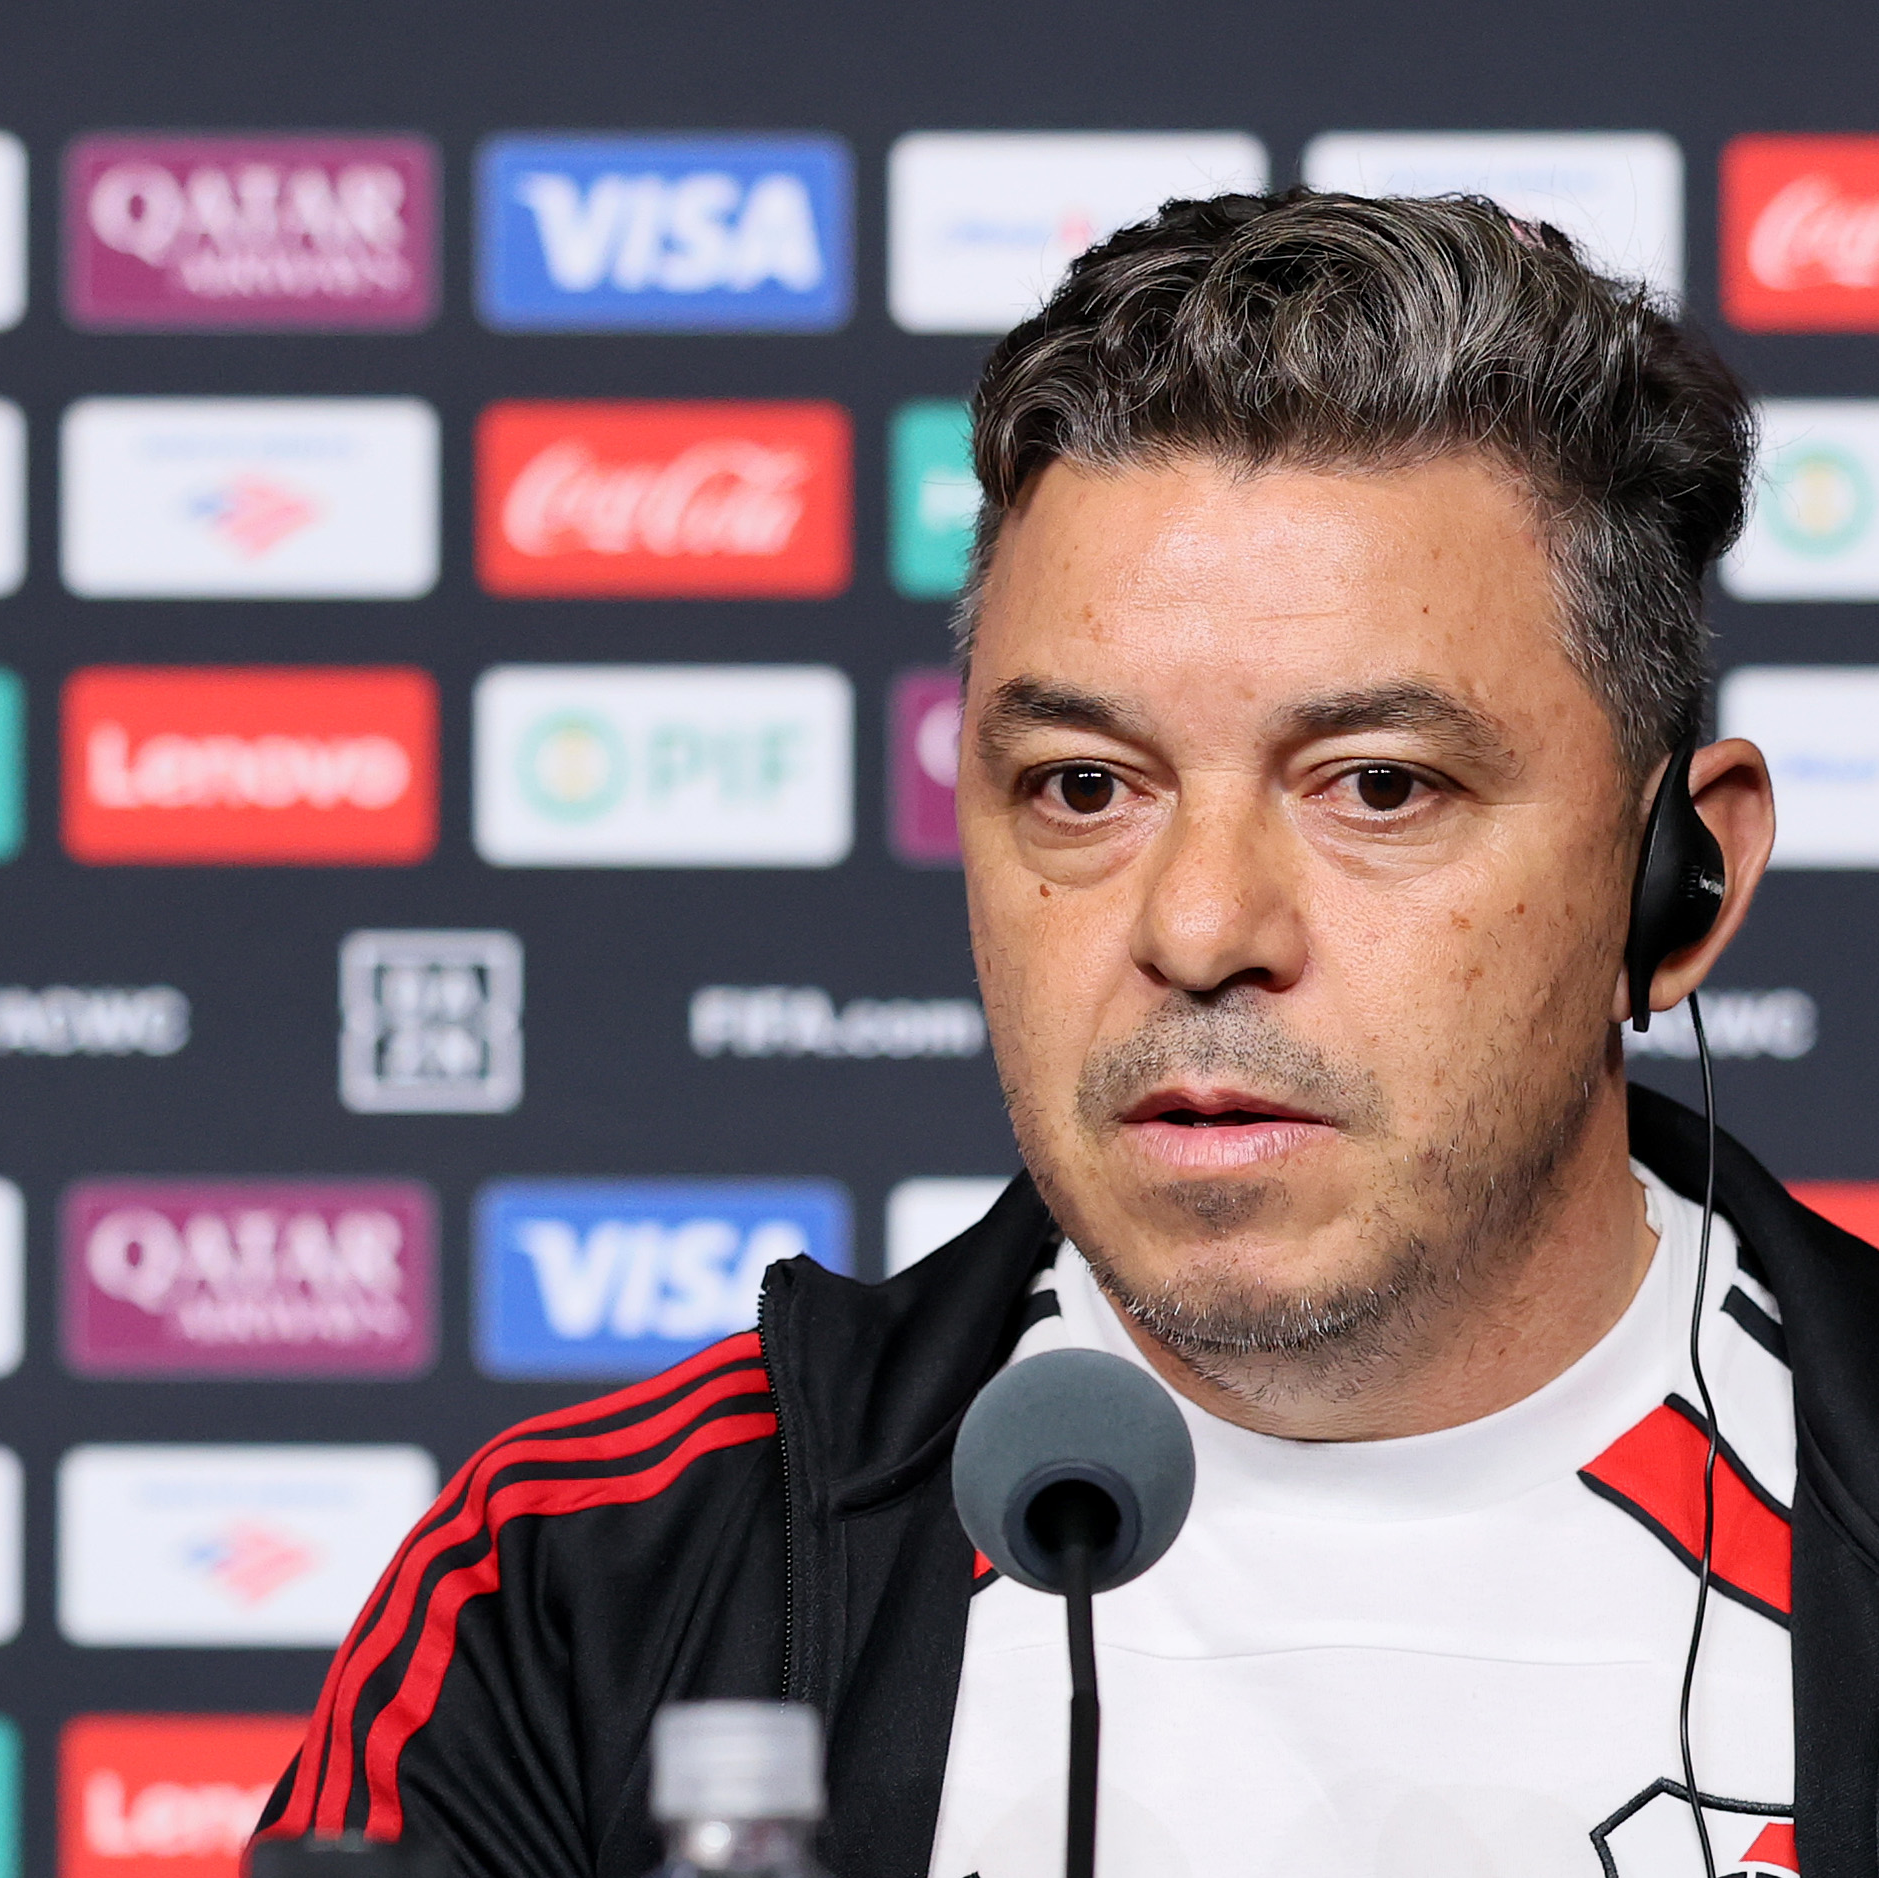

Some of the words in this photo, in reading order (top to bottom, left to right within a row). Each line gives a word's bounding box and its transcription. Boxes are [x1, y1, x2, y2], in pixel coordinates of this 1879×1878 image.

[90, 165, 406, 269] QATAR
[520, 173, 822, 292] VISA
[88, 726, 410, 808] Lenovo
[641, 721, 804, 803] PIF
[88, 1211, 402, 1315] QATAR
[518, 1219, 809, 1321] VISA
[84, 1767, 275, 1858] Len
